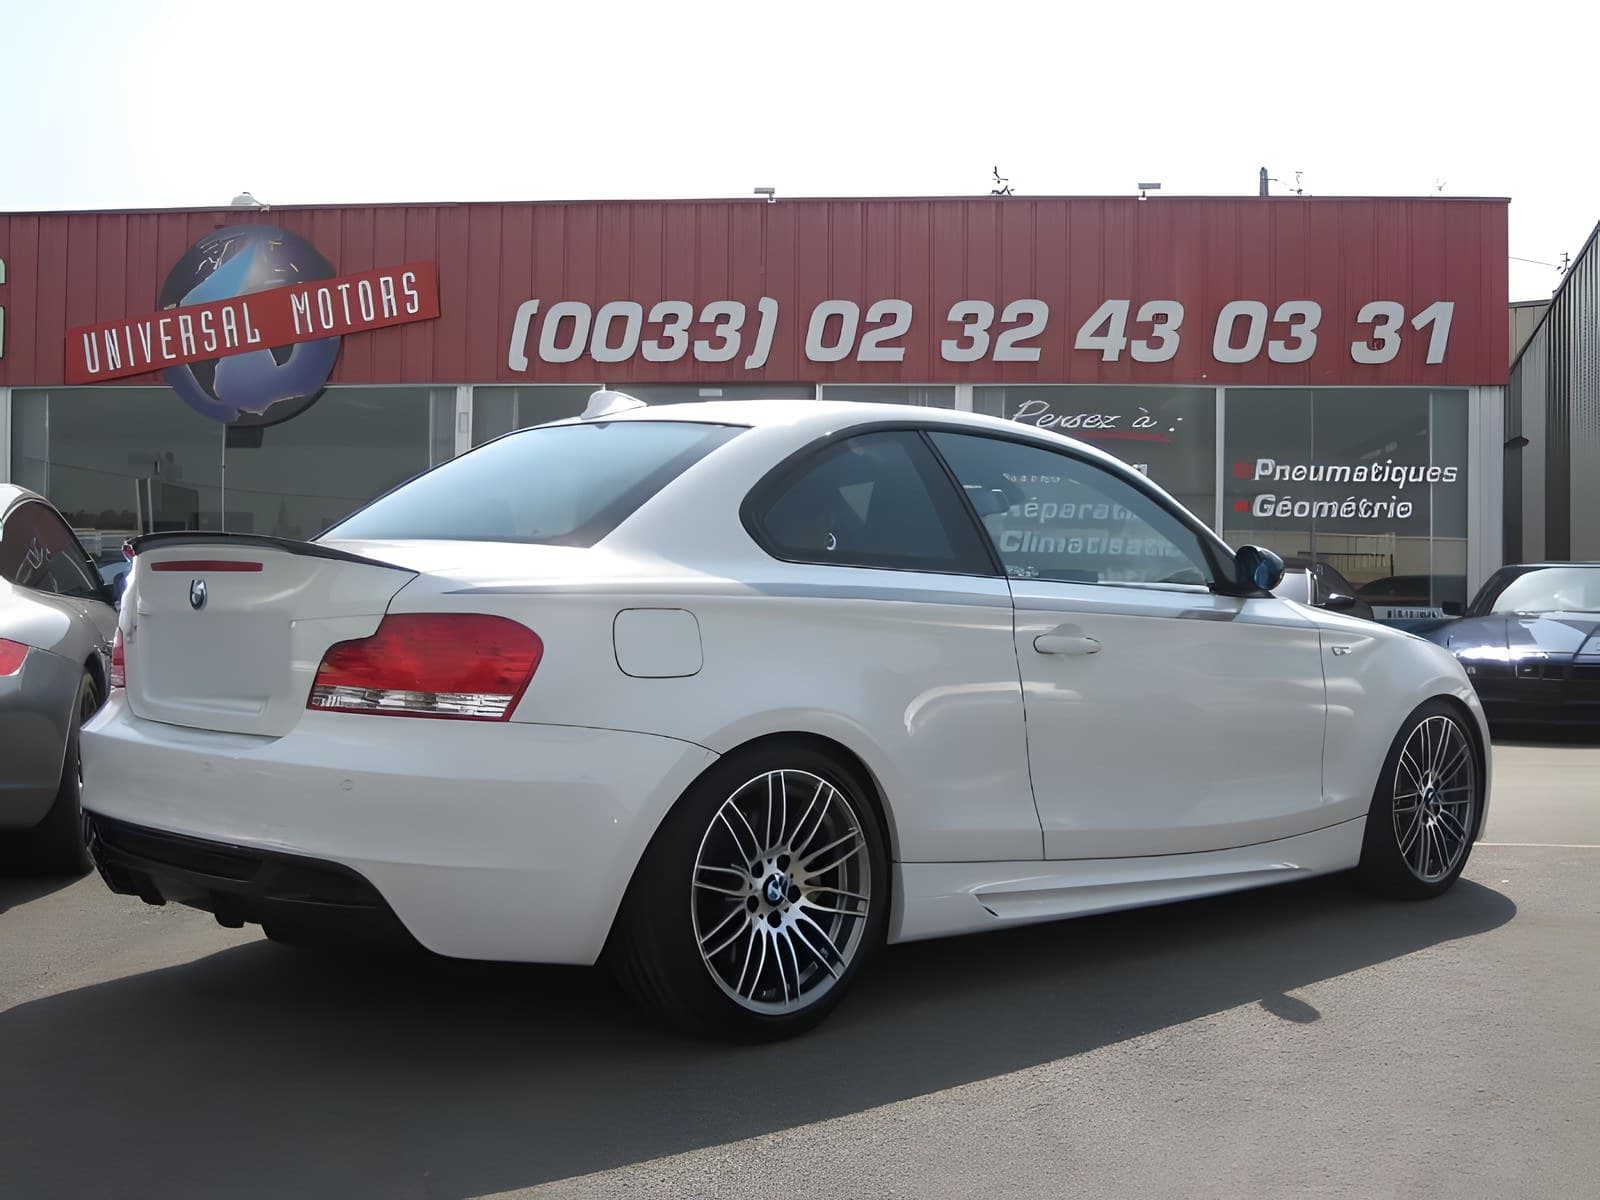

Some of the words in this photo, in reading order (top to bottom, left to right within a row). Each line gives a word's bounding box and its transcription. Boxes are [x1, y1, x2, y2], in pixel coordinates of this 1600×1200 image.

[82, 302, 261, 374] UNIVERSAL
[290, 271, 420, 335] MOTORS
[508, 296, 779, 372] (0033)
[804, 299, 913, 363] 02
[940, 299, 1050, 363] 32
[1073, 298, 1185, 364] 43
[1212, 300, 1322, 364] 03
[1350, 301, 1455, 365] 31
[1254, 457, 1458, 489] Pneumatiques
